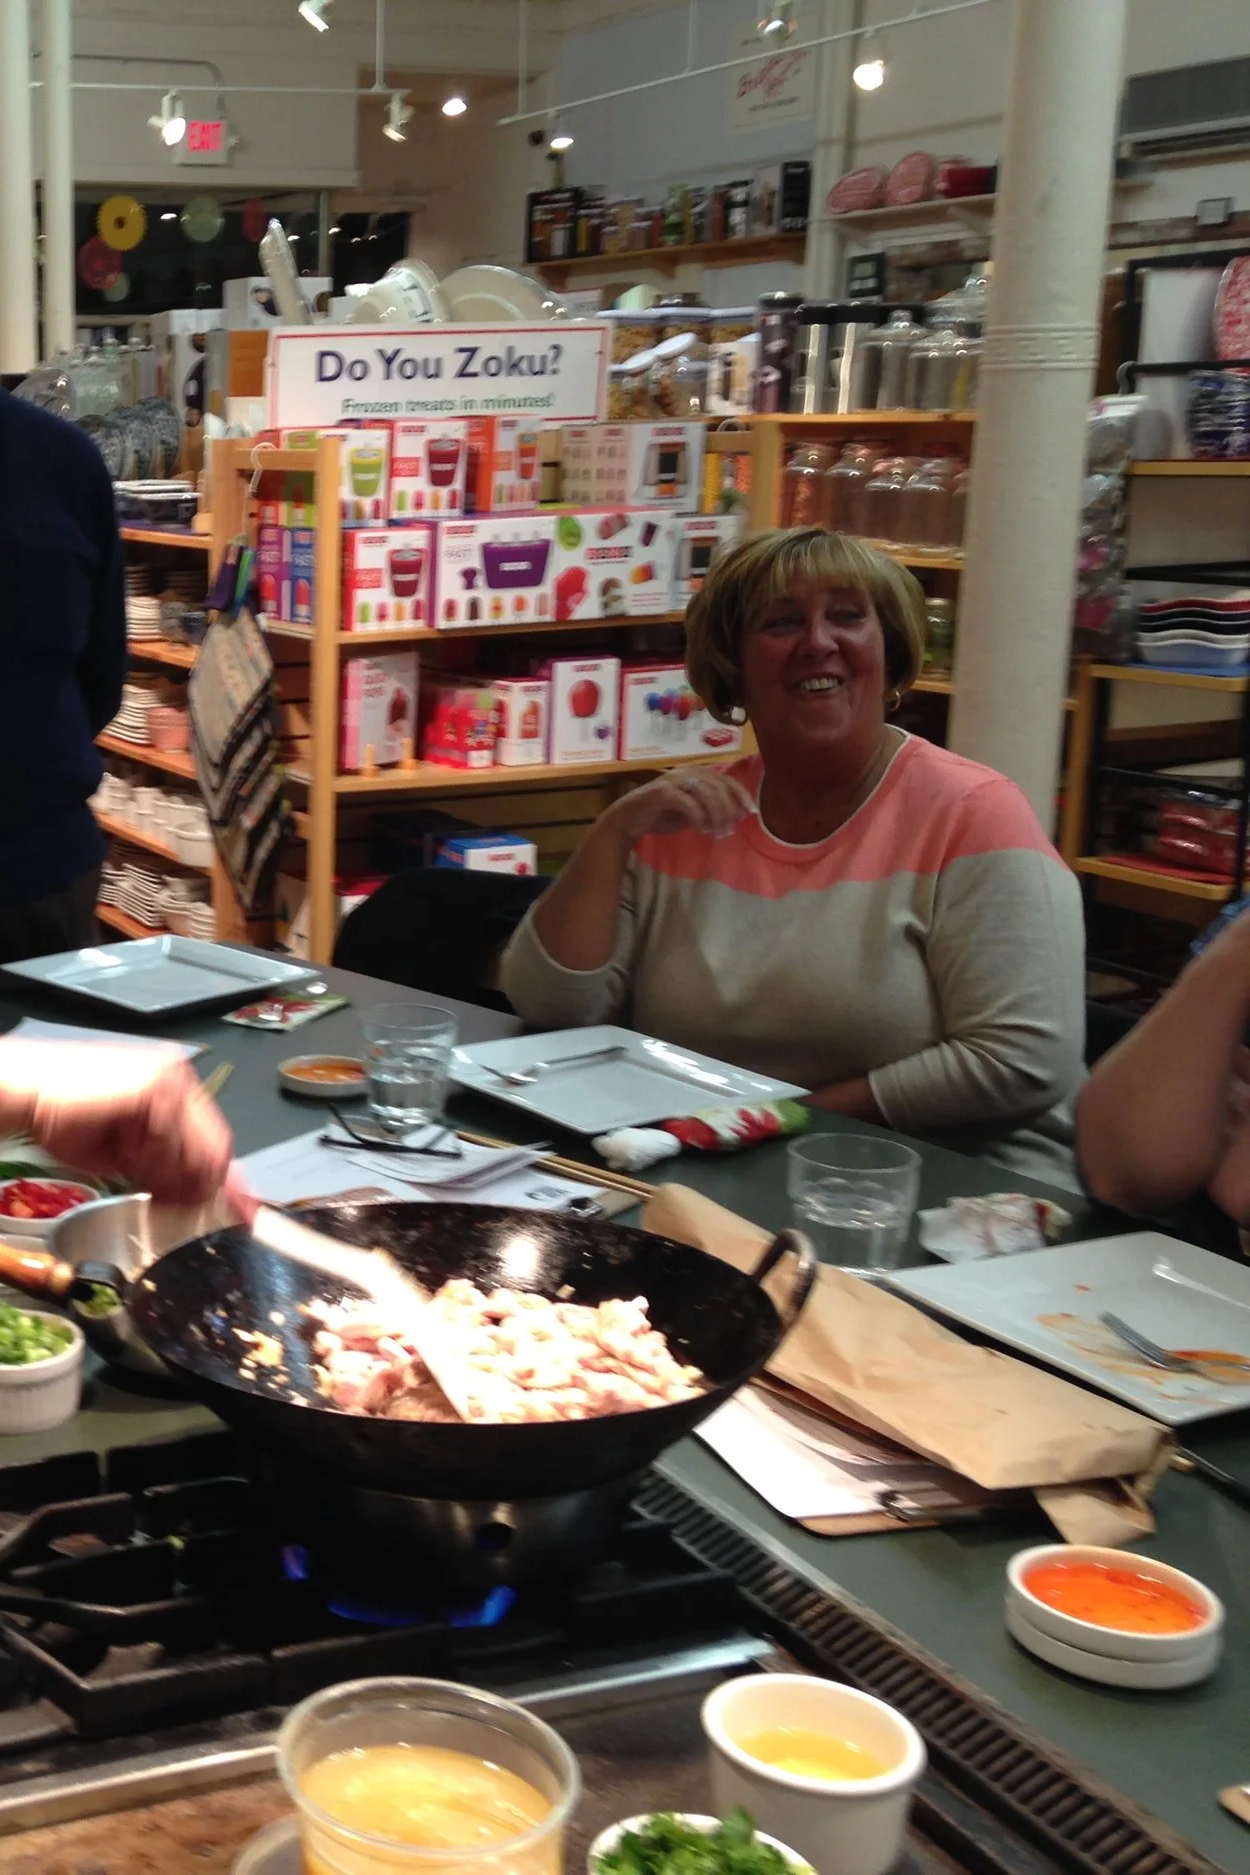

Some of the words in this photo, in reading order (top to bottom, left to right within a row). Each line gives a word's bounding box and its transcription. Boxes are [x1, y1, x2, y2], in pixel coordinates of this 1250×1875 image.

[315, 350, 370, 383] Do
[376, 347, 444, 381] You
[454, 343, 565, 379] Zoku?
[342, 398, 403, 415] Frozen
[405, 396, 457, 413] treats
[459, 395, 476, 411] in
